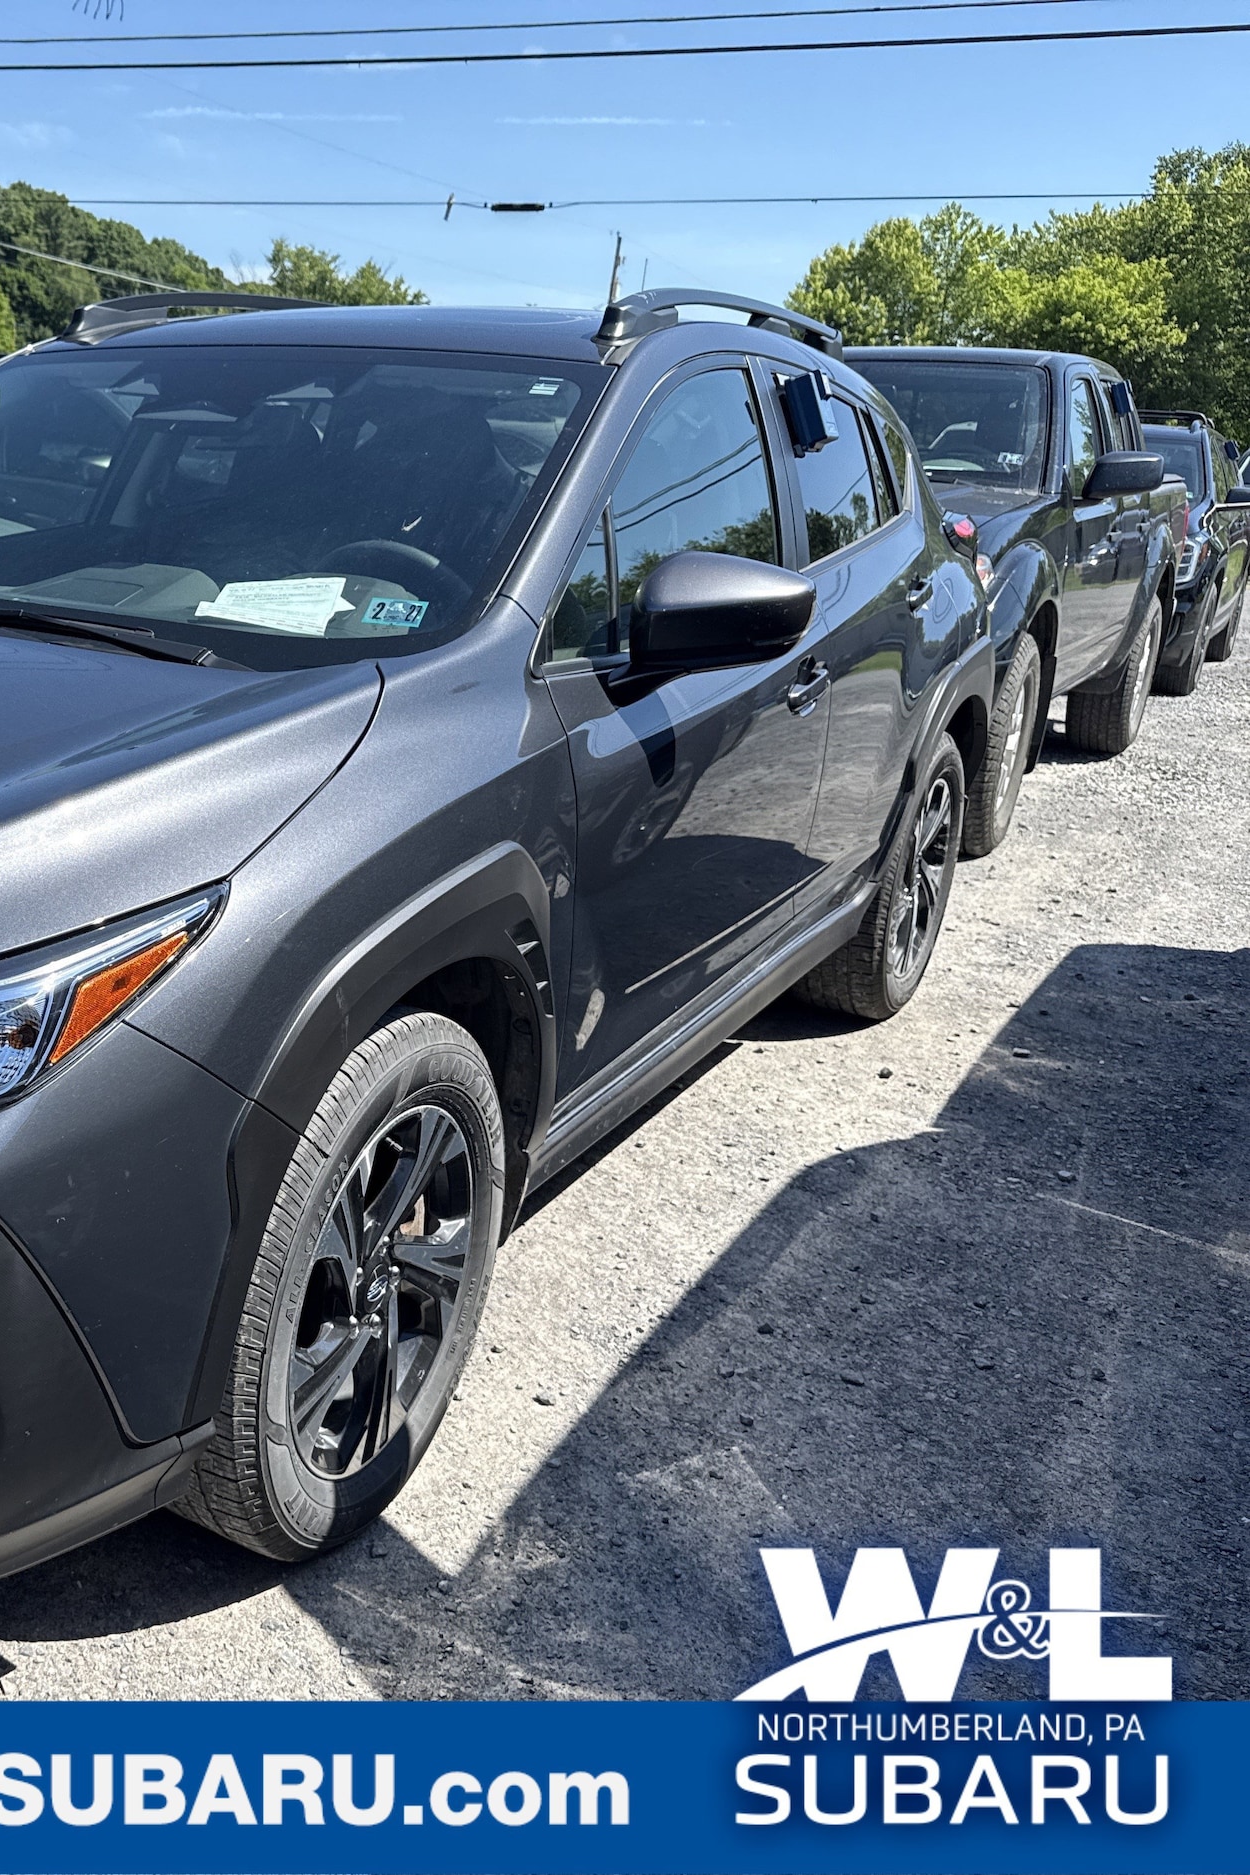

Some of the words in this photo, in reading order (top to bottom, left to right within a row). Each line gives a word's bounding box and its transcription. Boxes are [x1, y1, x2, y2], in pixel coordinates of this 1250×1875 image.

[372, 602, 386, 619] 2
[405, 605, 423, 623] 27
[428, 1057, 502, 1148] GOODYEAR
[285, 1155, 350, 1323] ALL-SEASON
